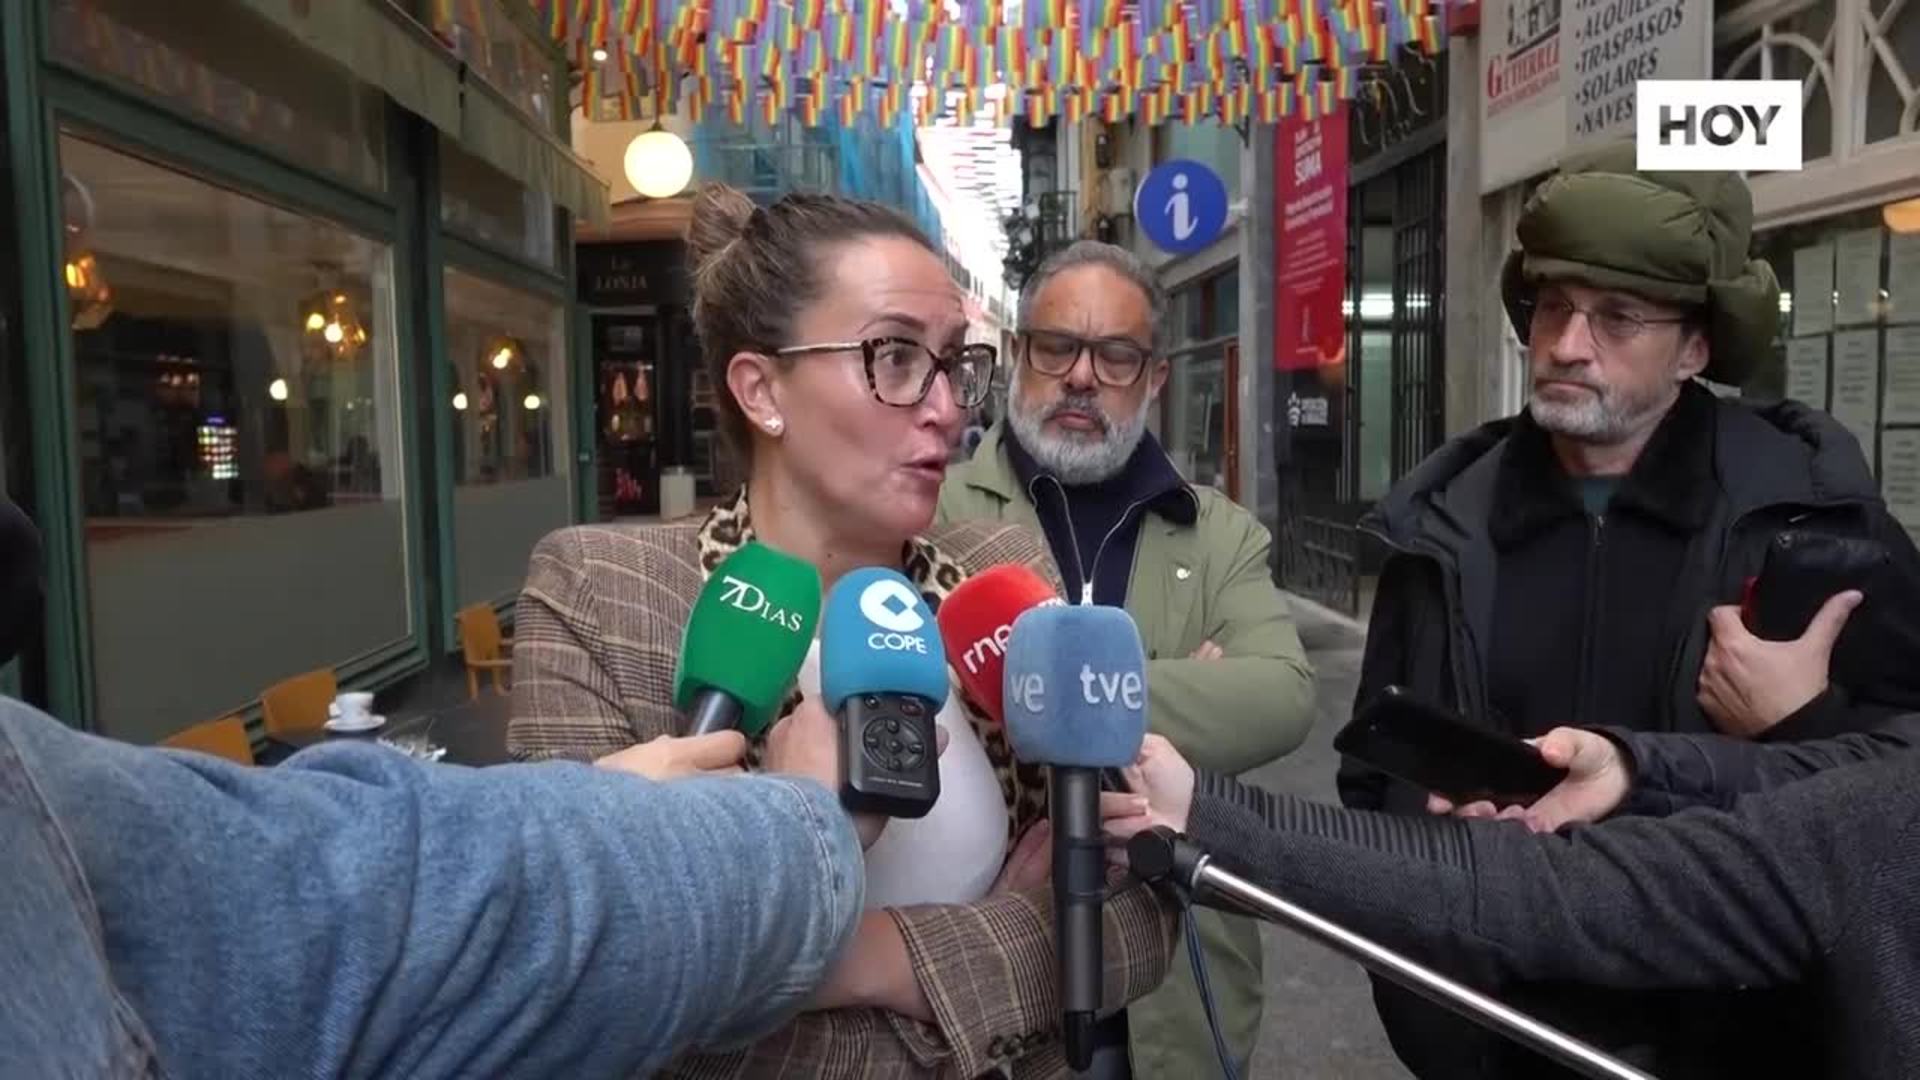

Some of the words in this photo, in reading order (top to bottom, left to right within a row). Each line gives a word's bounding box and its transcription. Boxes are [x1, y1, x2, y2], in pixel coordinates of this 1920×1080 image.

[1581, 0, 1685, 73] TRASPASOS
[1585, 0, 1654, 38] ALQUIL
[1582, 46, 1659, 106] SOLARES
[1582, 93, 1634, 134] NAVES
[868, 632, 928, 654] COPE
[962, 624, 1013, 675] rne
[1079, 663, 1144, 710] tve
